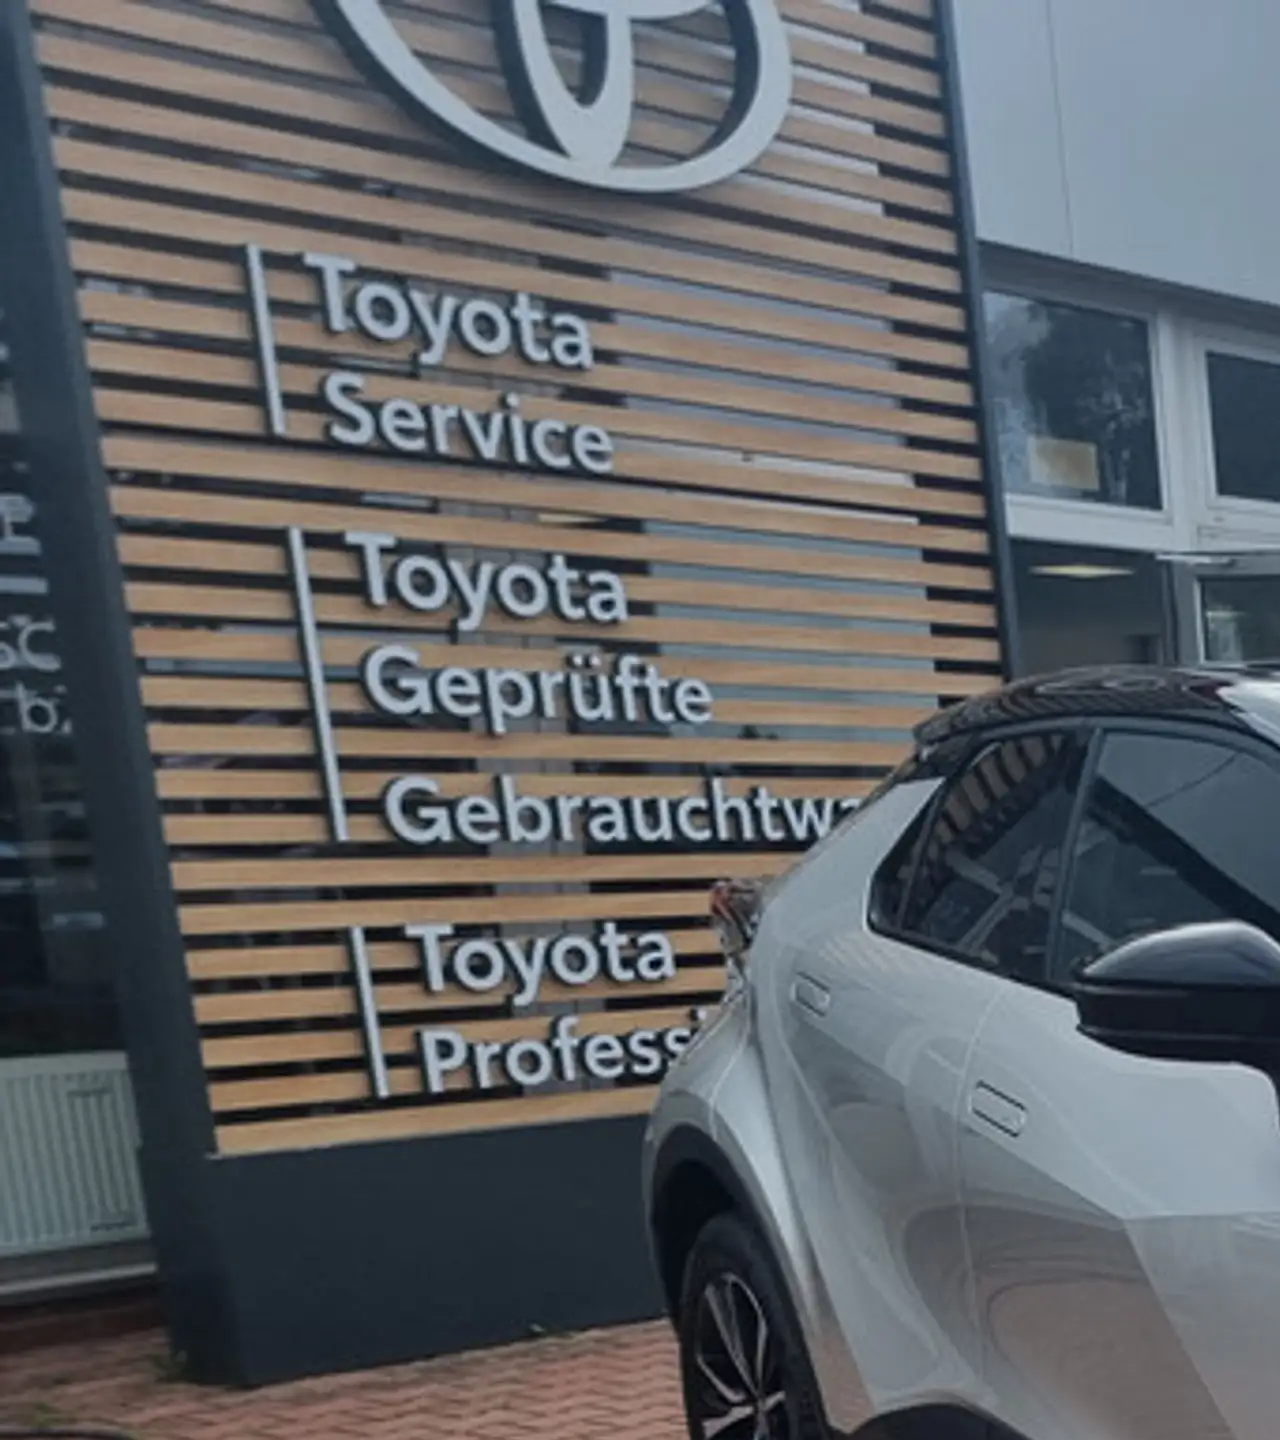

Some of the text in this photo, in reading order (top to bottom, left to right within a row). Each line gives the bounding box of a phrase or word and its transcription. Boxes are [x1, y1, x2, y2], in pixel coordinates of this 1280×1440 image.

[304, 254, 594, 370] Toyota
[323, 373, 615, 474] Service
[345, 532, 628, 632] Toyota
[363, 644, 714, 737] Geprüfte
[386, 775, 862, 843] Gebrauchtw
[405, 922, 677, 1006] Toyota
[420, 1007, 707, 1093] Profess
